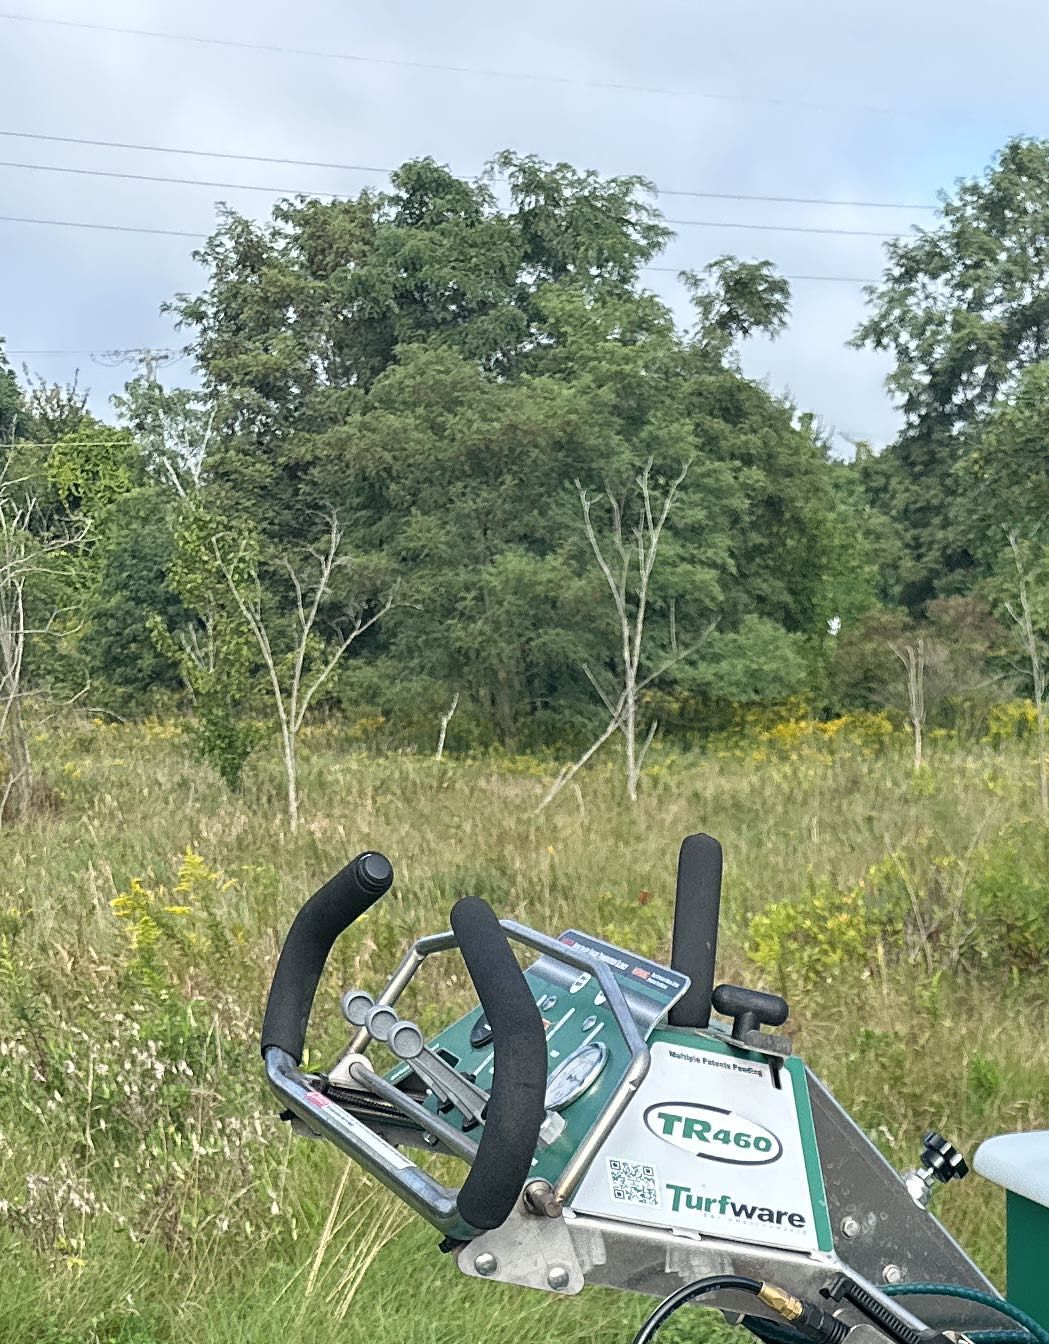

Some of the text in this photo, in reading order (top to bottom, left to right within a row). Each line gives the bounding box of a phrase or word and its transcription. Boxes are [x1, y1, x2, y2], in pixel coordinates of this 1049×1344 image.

[702, 1057, 731, 1070] Patents
[658, 1112, 772, 1152] TR460
[666, 1183, 806, 1228] Turfware
